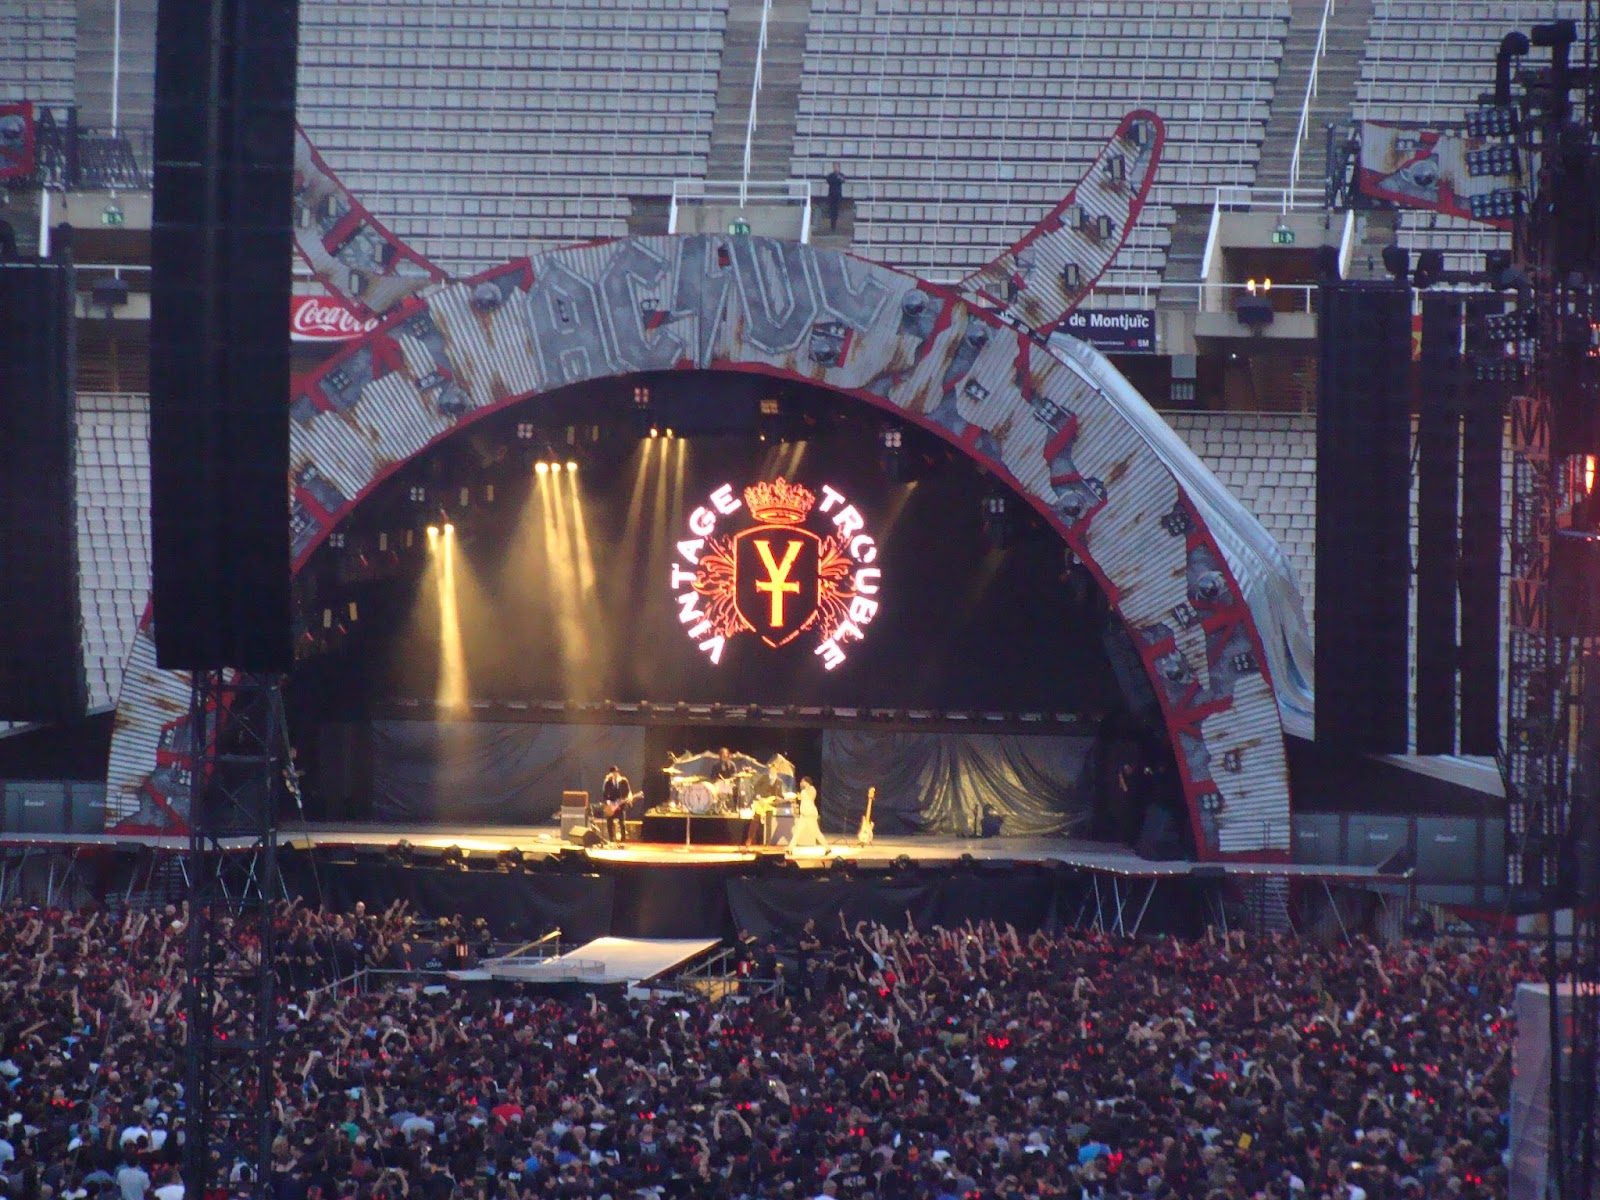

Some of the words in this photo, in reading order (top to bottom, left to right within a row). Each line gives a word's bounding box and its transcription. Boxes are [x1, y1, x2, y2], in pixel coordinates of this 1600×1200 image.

[1069, 313, 1086, 327] de
[1090, 313, 1149, 330] Montjuïc
[671, 483, 742, 665] VINTAGE
[814, 484, 881, 670] TROUBLE
